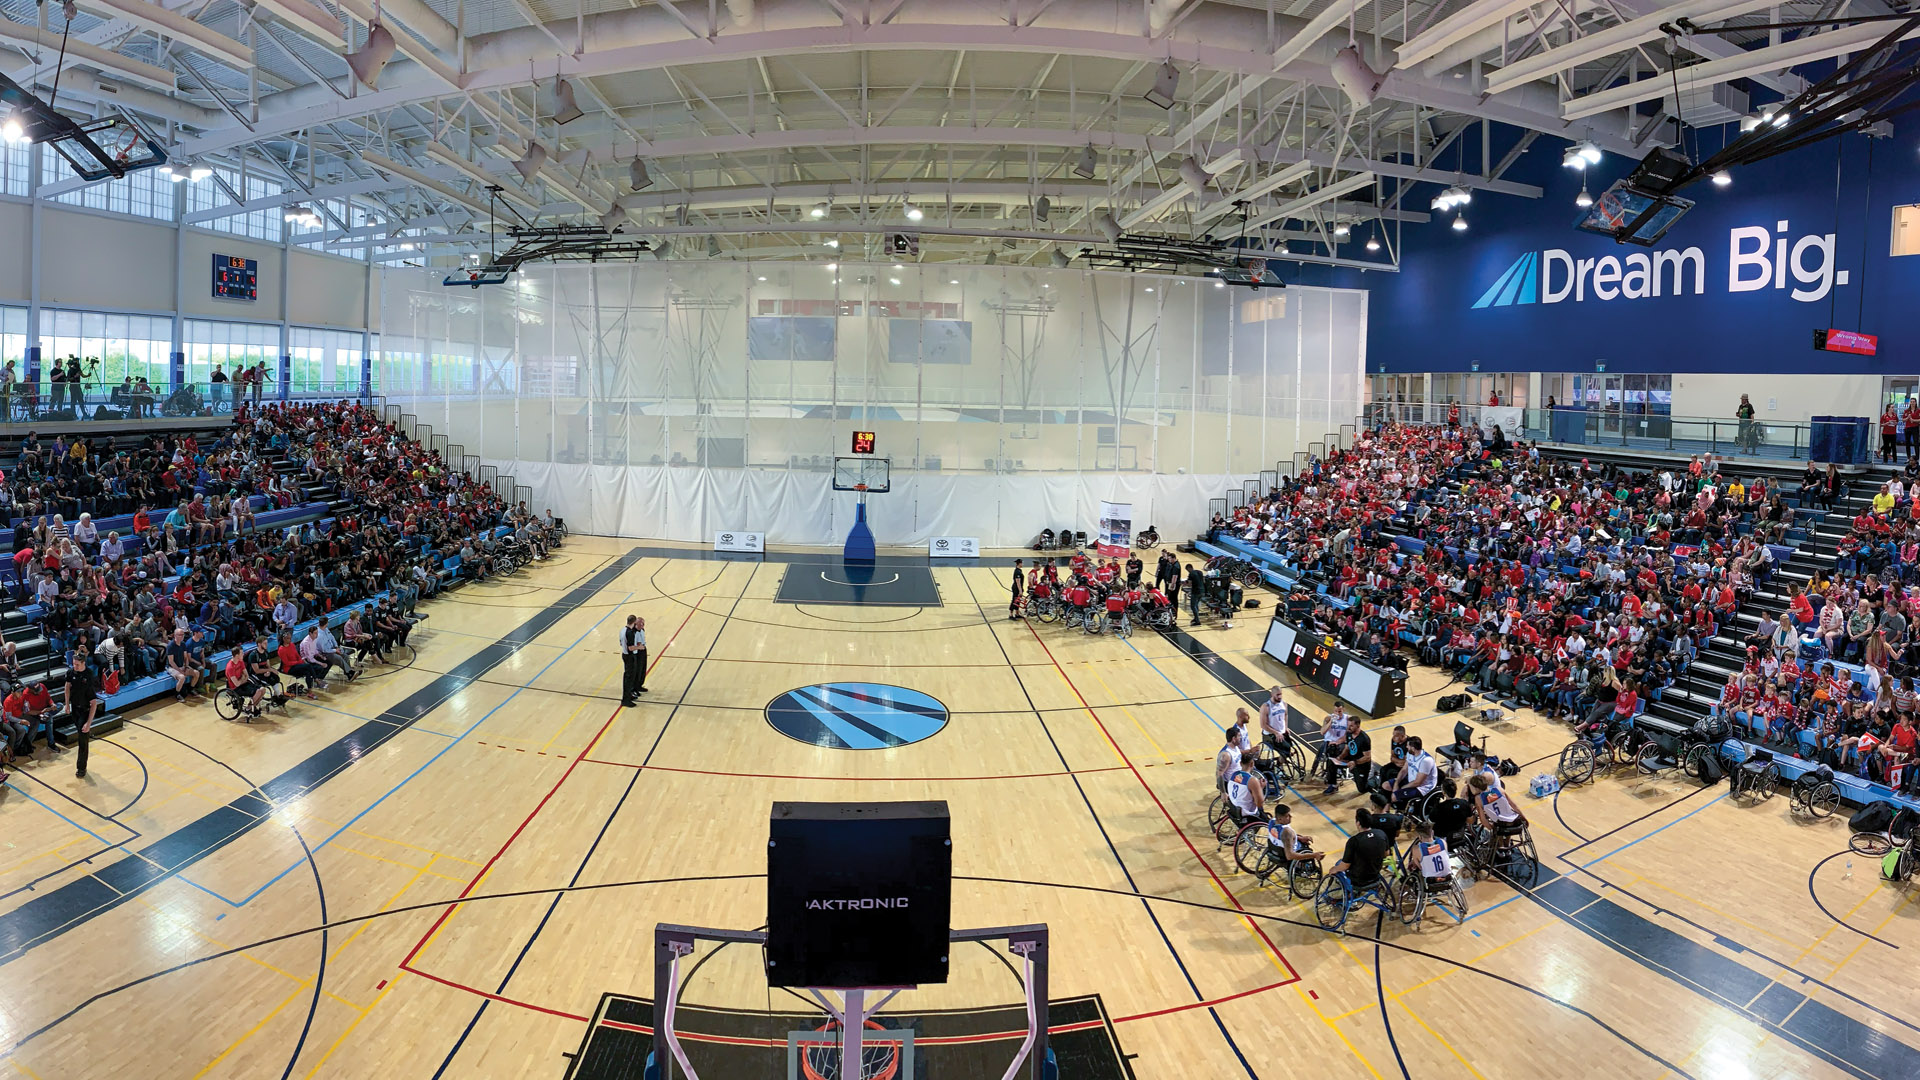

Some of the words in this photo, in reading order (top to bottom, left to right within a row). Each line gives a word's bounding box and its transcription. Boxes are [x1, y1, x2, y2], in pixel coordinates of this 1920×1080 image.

[1542, 246, 1705, 304] Dream
[1728, 219, 1849, 302] Big.
[1836, 332, 1857, 341] Wrong
[856, 439, 870, 452] 24
[1314, 645, 1329, 660] 6:38
[1492, 802, 1501, 816] 5
[1432, 855, 1444, 872] 16
[806, 897, 909, 910] AKTRONIC
